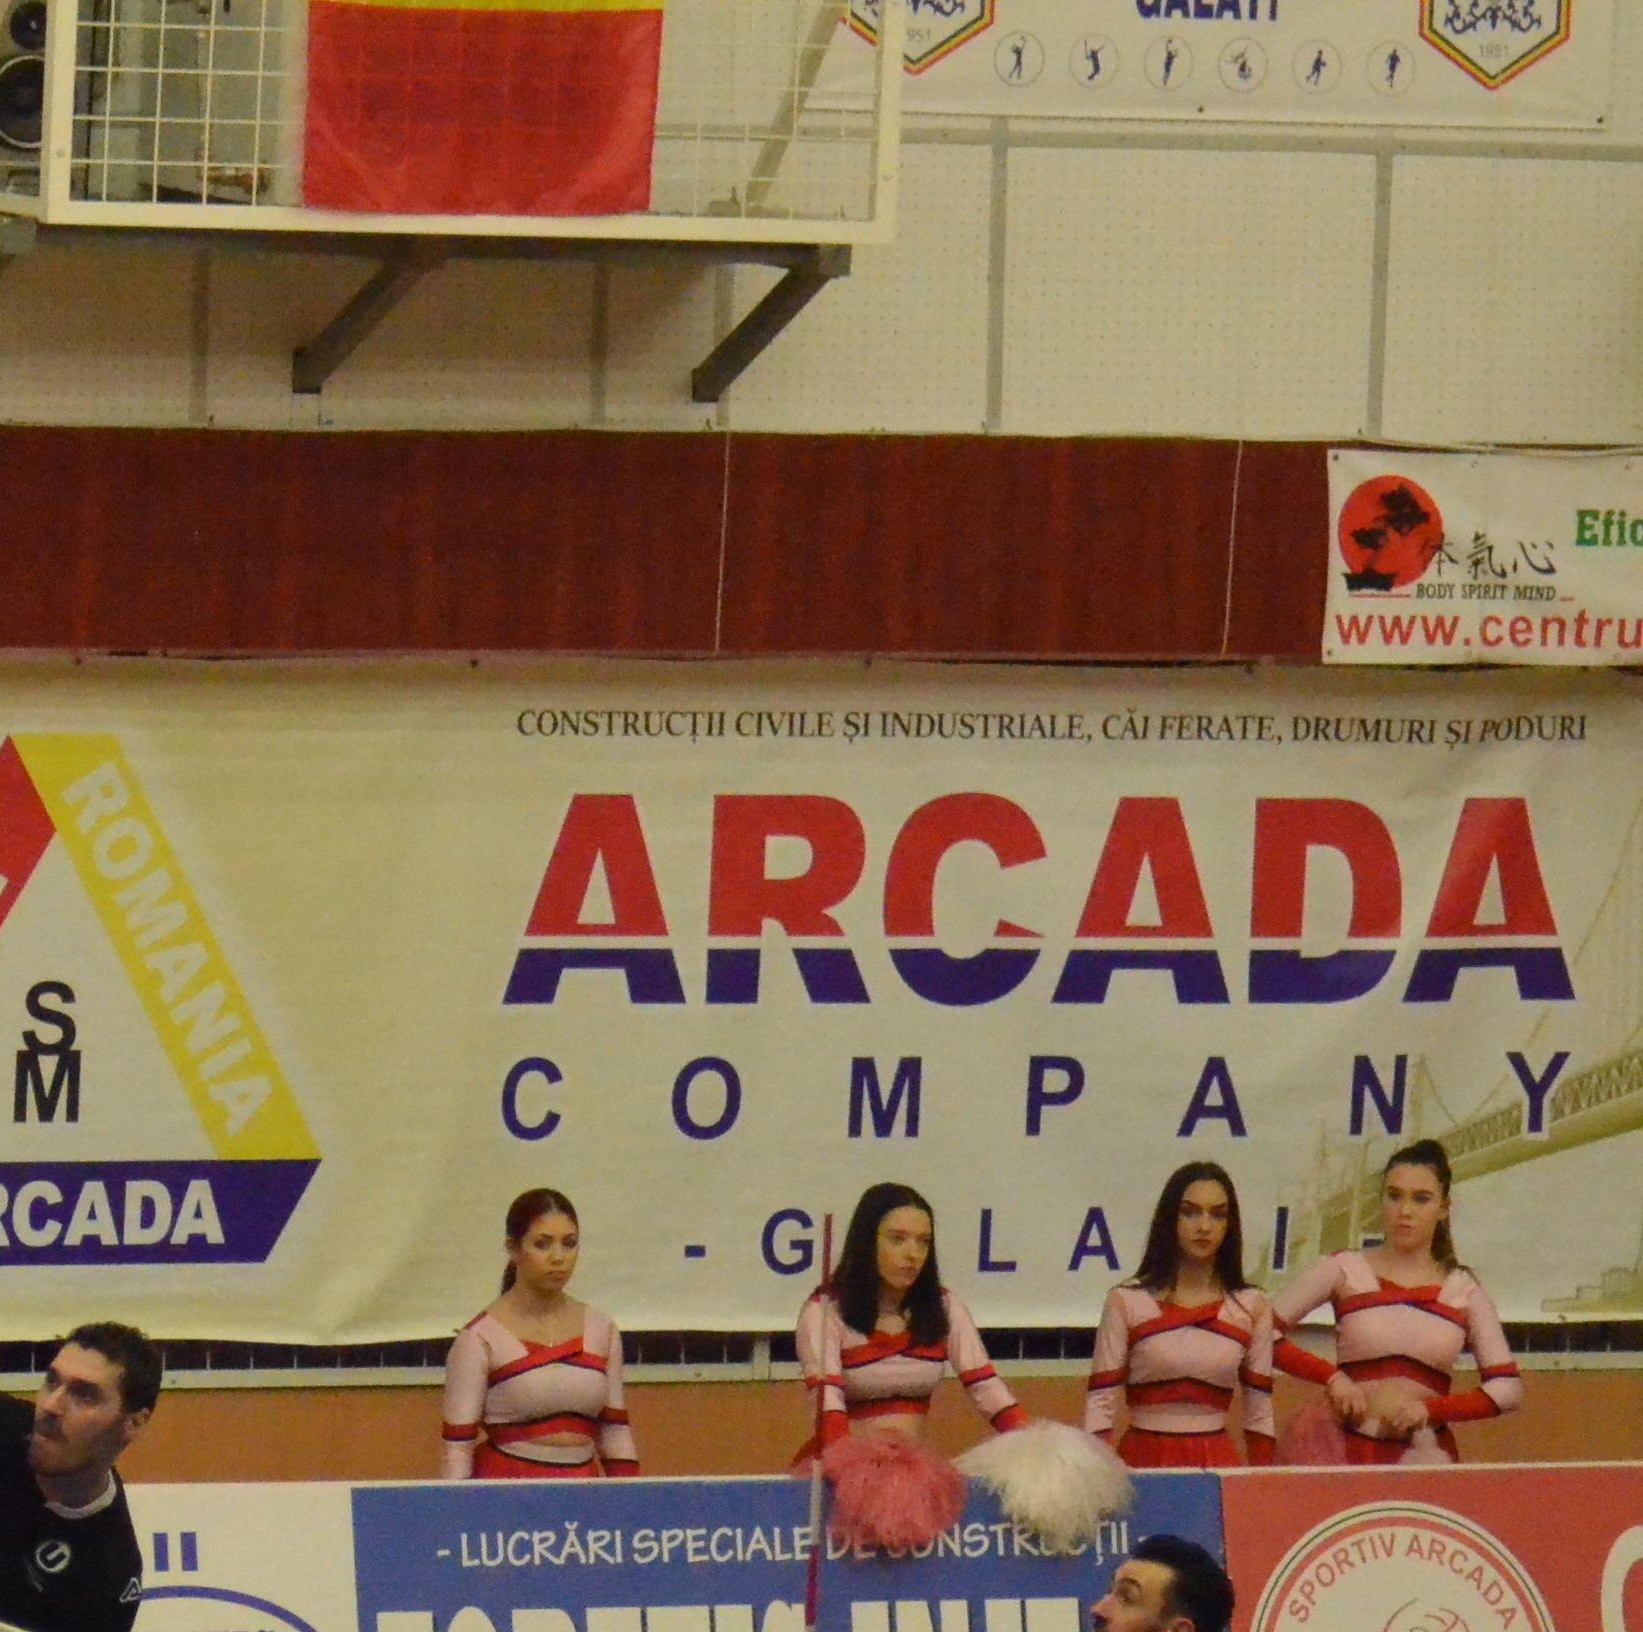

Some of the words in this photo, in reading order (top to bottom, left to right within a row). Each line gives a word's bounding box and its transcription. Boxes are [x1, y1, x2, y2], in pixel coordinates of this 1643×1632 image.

[1416, 584, 1456, 600] BODY
[1461, 584, 1508, 601] SPIRIT
[1514, 585, 1557, 602] MIND
[515, 708, 727, 745] CONSTRUCȚII
[734, 710, 836, 738] CIVILE
[842, 710, 869, 744] ȘI
[880, 711, 1093, 745] INDUSTRIALE,
[1102, 707, 1151, 741] CĂI
[1159, 715, 1283, 745] FERATE,
[1291, 715, 1436, 745] DRUMURI
[1445, 718, 1472, 751] ȘI
[1478, 713, 1588, 744] PODURI
[502, 791, 1578, 1007] ARCADA
[61, 761, 275, 1140] ROMANIA
[500, 1051, 1572, 1140] COMPANY
[761, 1205, 1290, 1276] GLAI
[460, 1521, 623, 1568] LUCRĂRI
[631, 1525, 814, 1565] SPECIALE
[1288, 1531, 1397, 1624] SPORTIV
[1404, 1532, 1516, 1630] ARCADA
